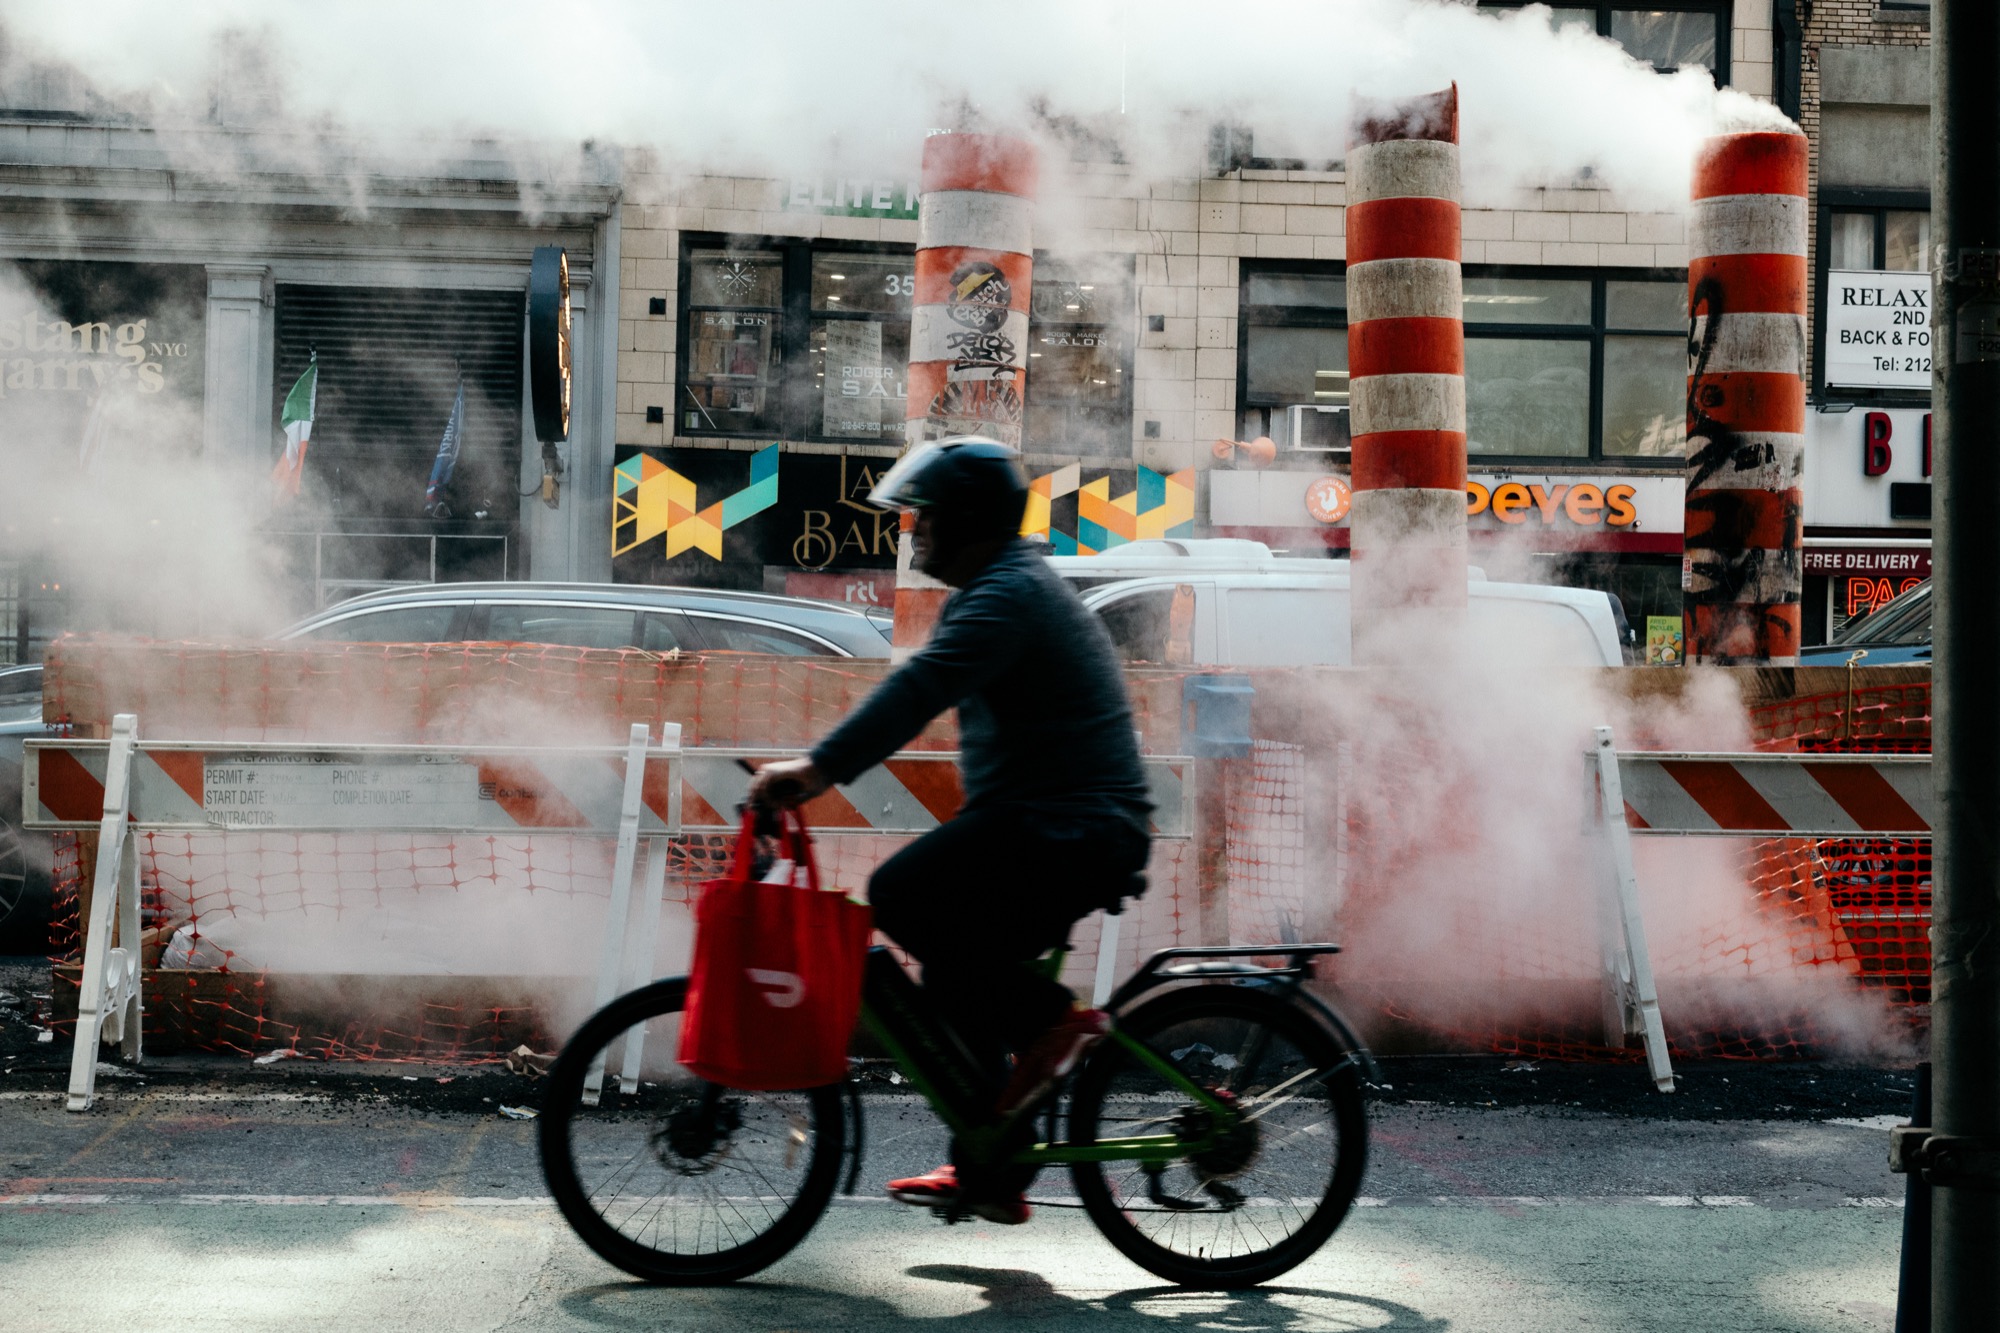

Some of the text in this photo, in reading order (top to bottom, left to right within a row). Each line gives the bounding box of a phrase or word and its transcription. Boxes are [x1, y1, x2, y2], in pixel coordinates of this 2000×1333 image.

[788, 177, 895, 210] ELITE
[1963, 254, 2000, 278] PE
[1841, 287, 1928, 308] RELAX
[705, 317, 768, 325] SALON
[1893, 310, 1925, 325] 2ND
[1046, 337, 1108, 346] SALON
[1840, 329, 1887, 345] BACK
[1892, 331, 1903, 345] &
[150, 342, 187, 357] NYC
[1873, 356, 1931, 372] Tel: 212
[841, 366, 894, 379] ROGER
[793, 510, 900, 568] BAK
[1804, 554, 1920, 569] FREE DELIVERY
[206, 770, 242, 784] PERMIT
[247, 770, 259, 784] #:
[332, 770, 368, 785] PHONE
[206, 790, 237, 804] START
[240, 790, 267, 804] DATE:
[333, 790, 388, 805] COMPLETION
[390, 790, 413, 804] DATE:
